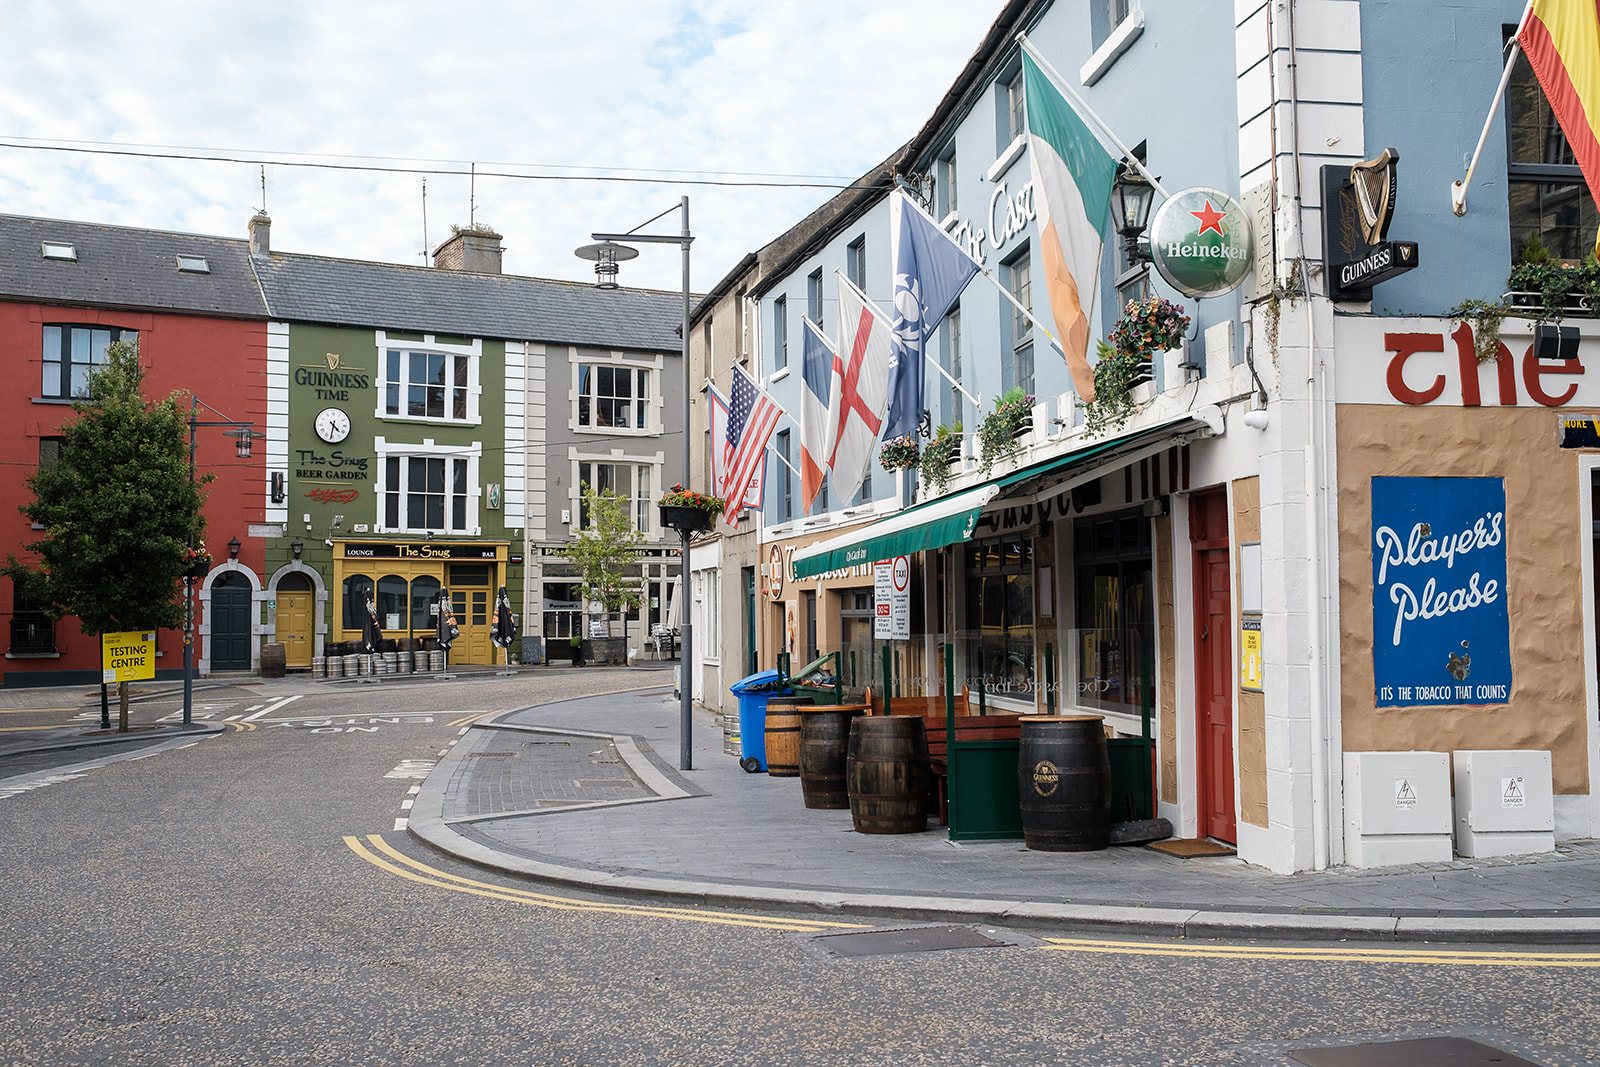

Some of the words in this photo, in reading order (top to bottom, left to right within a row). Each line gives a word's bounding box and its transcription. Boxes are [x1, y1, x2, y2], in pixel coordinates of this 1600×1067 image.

[989, 181, 1037, 249] Cast
[1167, 241, 1247, 260] Heineken
[1341, 249, 1391, 284] GUINNESS
[1384, 321, 1585, 406] The
[295, 368, 369, 389] GUINNESS
[315, 389, 349, 401] TIME
[1559, 419, 1588, 429] SMOKE
[296, 450, 326, 466] The
[329, 451, 369, 470] Snug
[296, 469, 323, 479] BEER
[325, 471, 368, 480] GARDEN
[347, 549, 374, 557] LOUNGE
[395, 545, 419, 558] The
[420, 545, 451, 559] Snug
[1376, 512, 1503, 585] Player's
[1390, 572, 1498, 646] Please
[110, 645, 147, 657] TESTING
[111, 657, 146, 669] CENTRE
[1380, 684, 1394, 700] IT'S
[1398, 686, 1412, 700] THE
[1415, 686, 1451, 700] TOBACCO
[1455, 685, 1473, 699] THAT
[1476, 685, 1507, 699] COUNTS
